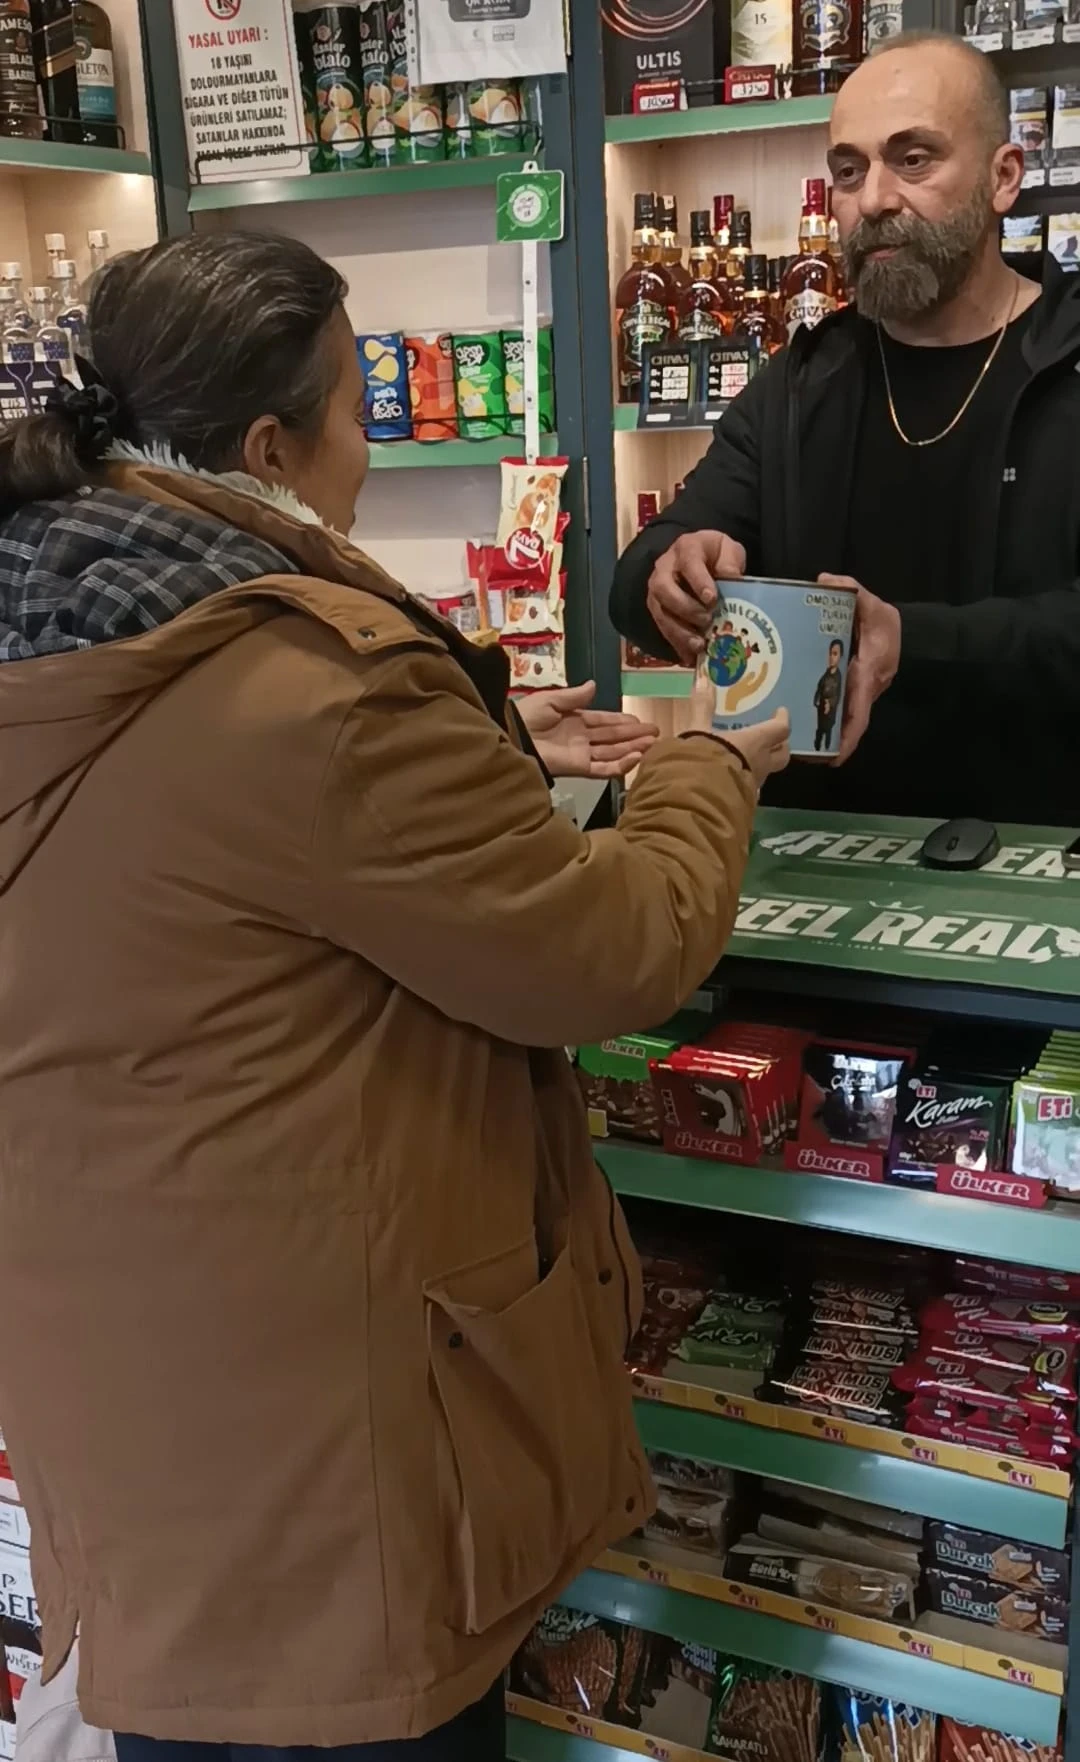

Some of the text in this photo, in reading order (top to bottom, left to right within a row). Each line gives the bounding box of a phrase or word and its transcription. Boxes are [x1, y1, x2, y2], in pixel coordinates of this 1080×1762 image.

[754, 12, 767, 25] 15
[188, 31, 225, 48] YASAL
[227, 26, 261, 46] UYARI
[210, 53, 252, 70] 18 YAŞINI
[636, 50, 682, 70] ULTIS
[190, 69, 278, 91] DOLDURMAYANLARA
[217, 93, 229, 106] VE
[259, 84, 289, 101] TÜTÜN
[196, 124, 286, 145] SATANLAR HAKKINDA
[651, 354, 690, 366] CHIVAS
[709, 351, 750, 363] CHIVAS
[800, 831, 924, 866] FEEL
[851, 910, 1055, 964] REAL
[602, 1039, 646, 1060] ÜLKER
[905, 1095, 994, 1129] Karam
[674, 1131, 744, 1159] ÜLKER
[797, 1148, 872, 1179] ÜLKER
[950, 1170, 1031, 1202] ÜLKER
[912, 1447, 938, 1462] ETi
[1009, 1470, 1036, 1487] ETi
[936, 1541, 995, 1571] Burçak
[941, 1590, 1000, 1619] Burçak
[1008, 1668, 1035, 1686] ETi
